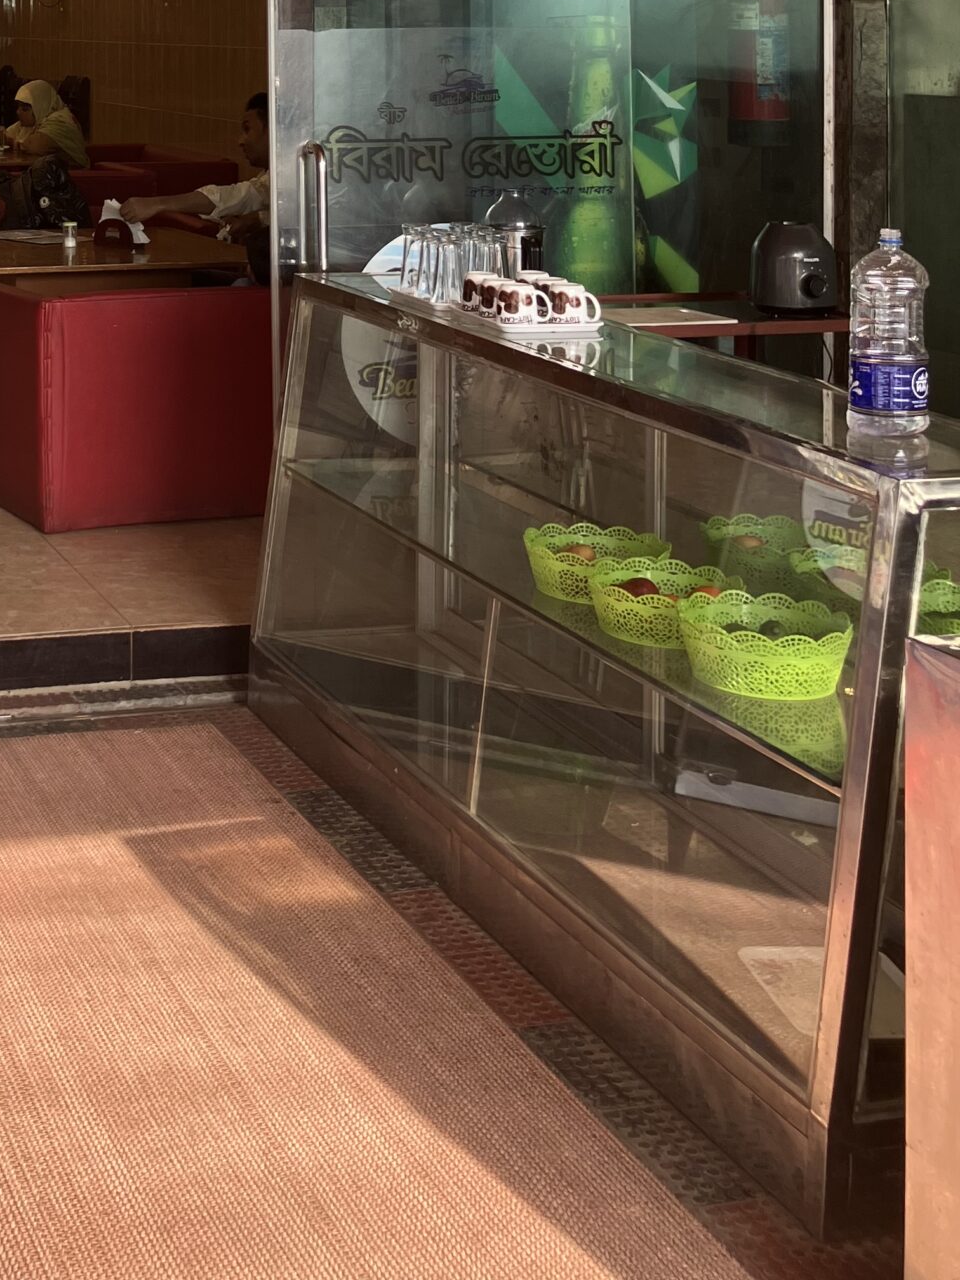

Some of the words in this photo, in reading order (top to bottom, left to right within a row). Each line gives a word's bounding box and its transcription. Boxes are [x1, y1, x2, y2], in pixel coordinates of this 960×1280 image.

[377, 102, 406, 125] বীচ
[324, 125, 451, 183] বিরাম
[461, 120, 623, 179] রেস্তোরাঁ
